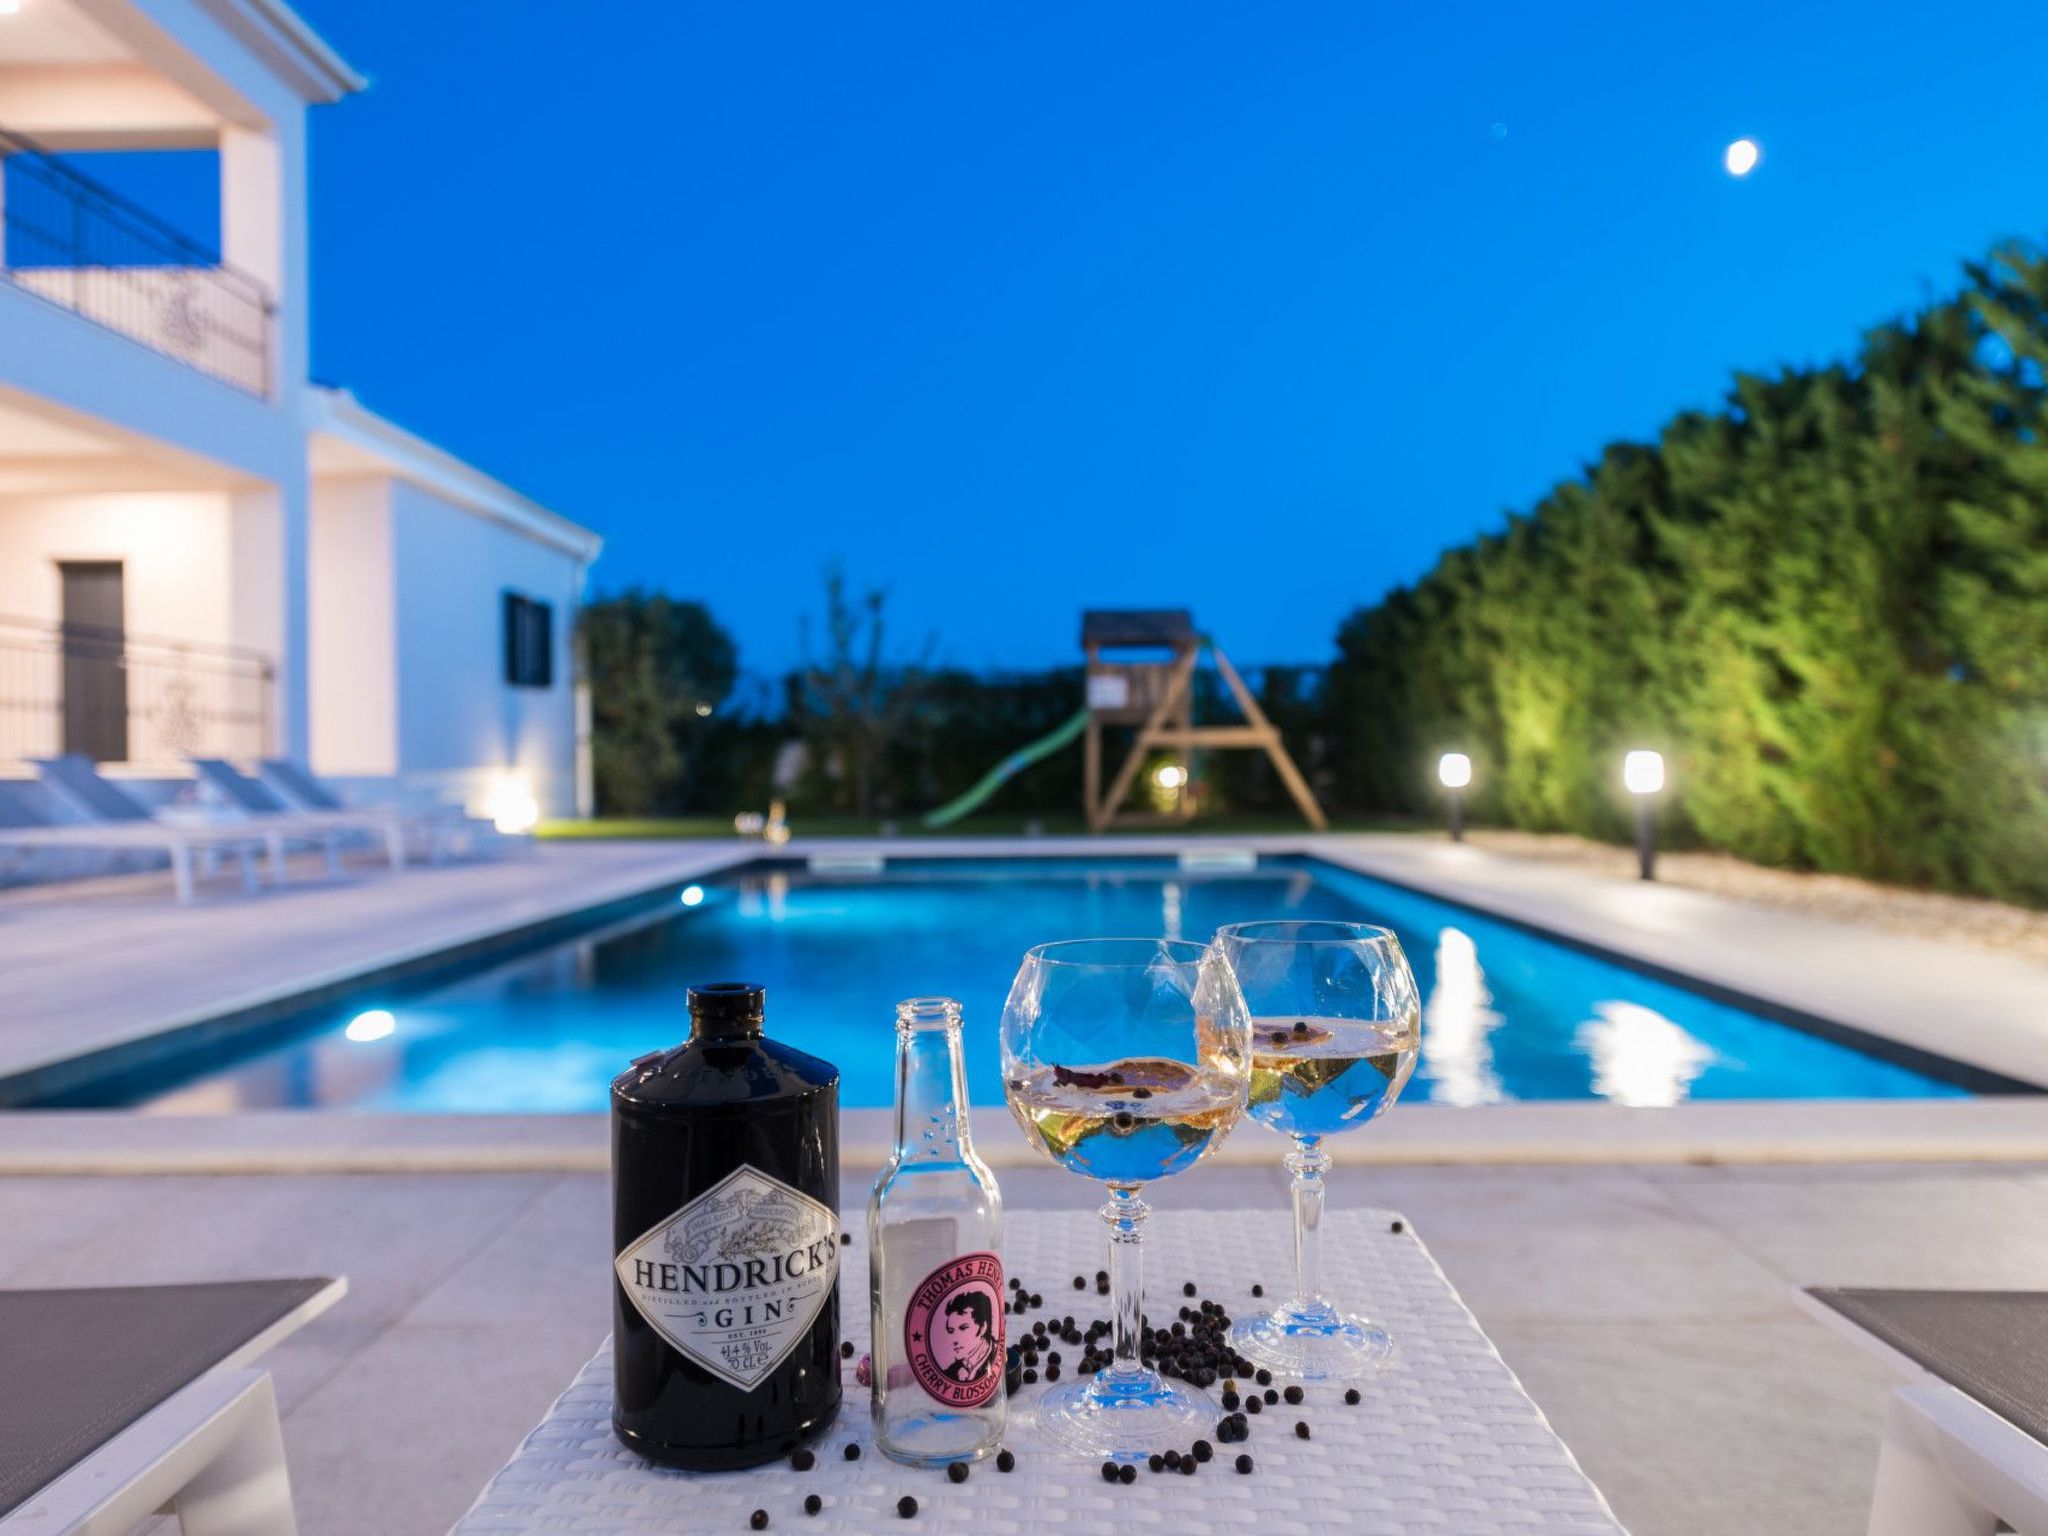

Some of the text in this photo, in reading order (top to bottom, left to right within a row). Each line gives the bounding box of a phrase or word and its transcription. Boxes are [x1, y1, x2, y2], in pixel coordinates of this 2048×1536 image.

[634, 1232, 836, 1293] HENDRICK'S
[918, 1262, 973, 1311] THOMAS
[715, 1299, 782, 1328] GIN
[914, 1353, 952, 1396] CHERRY
[952, 1373, 997, 1400] BLOSSOM
